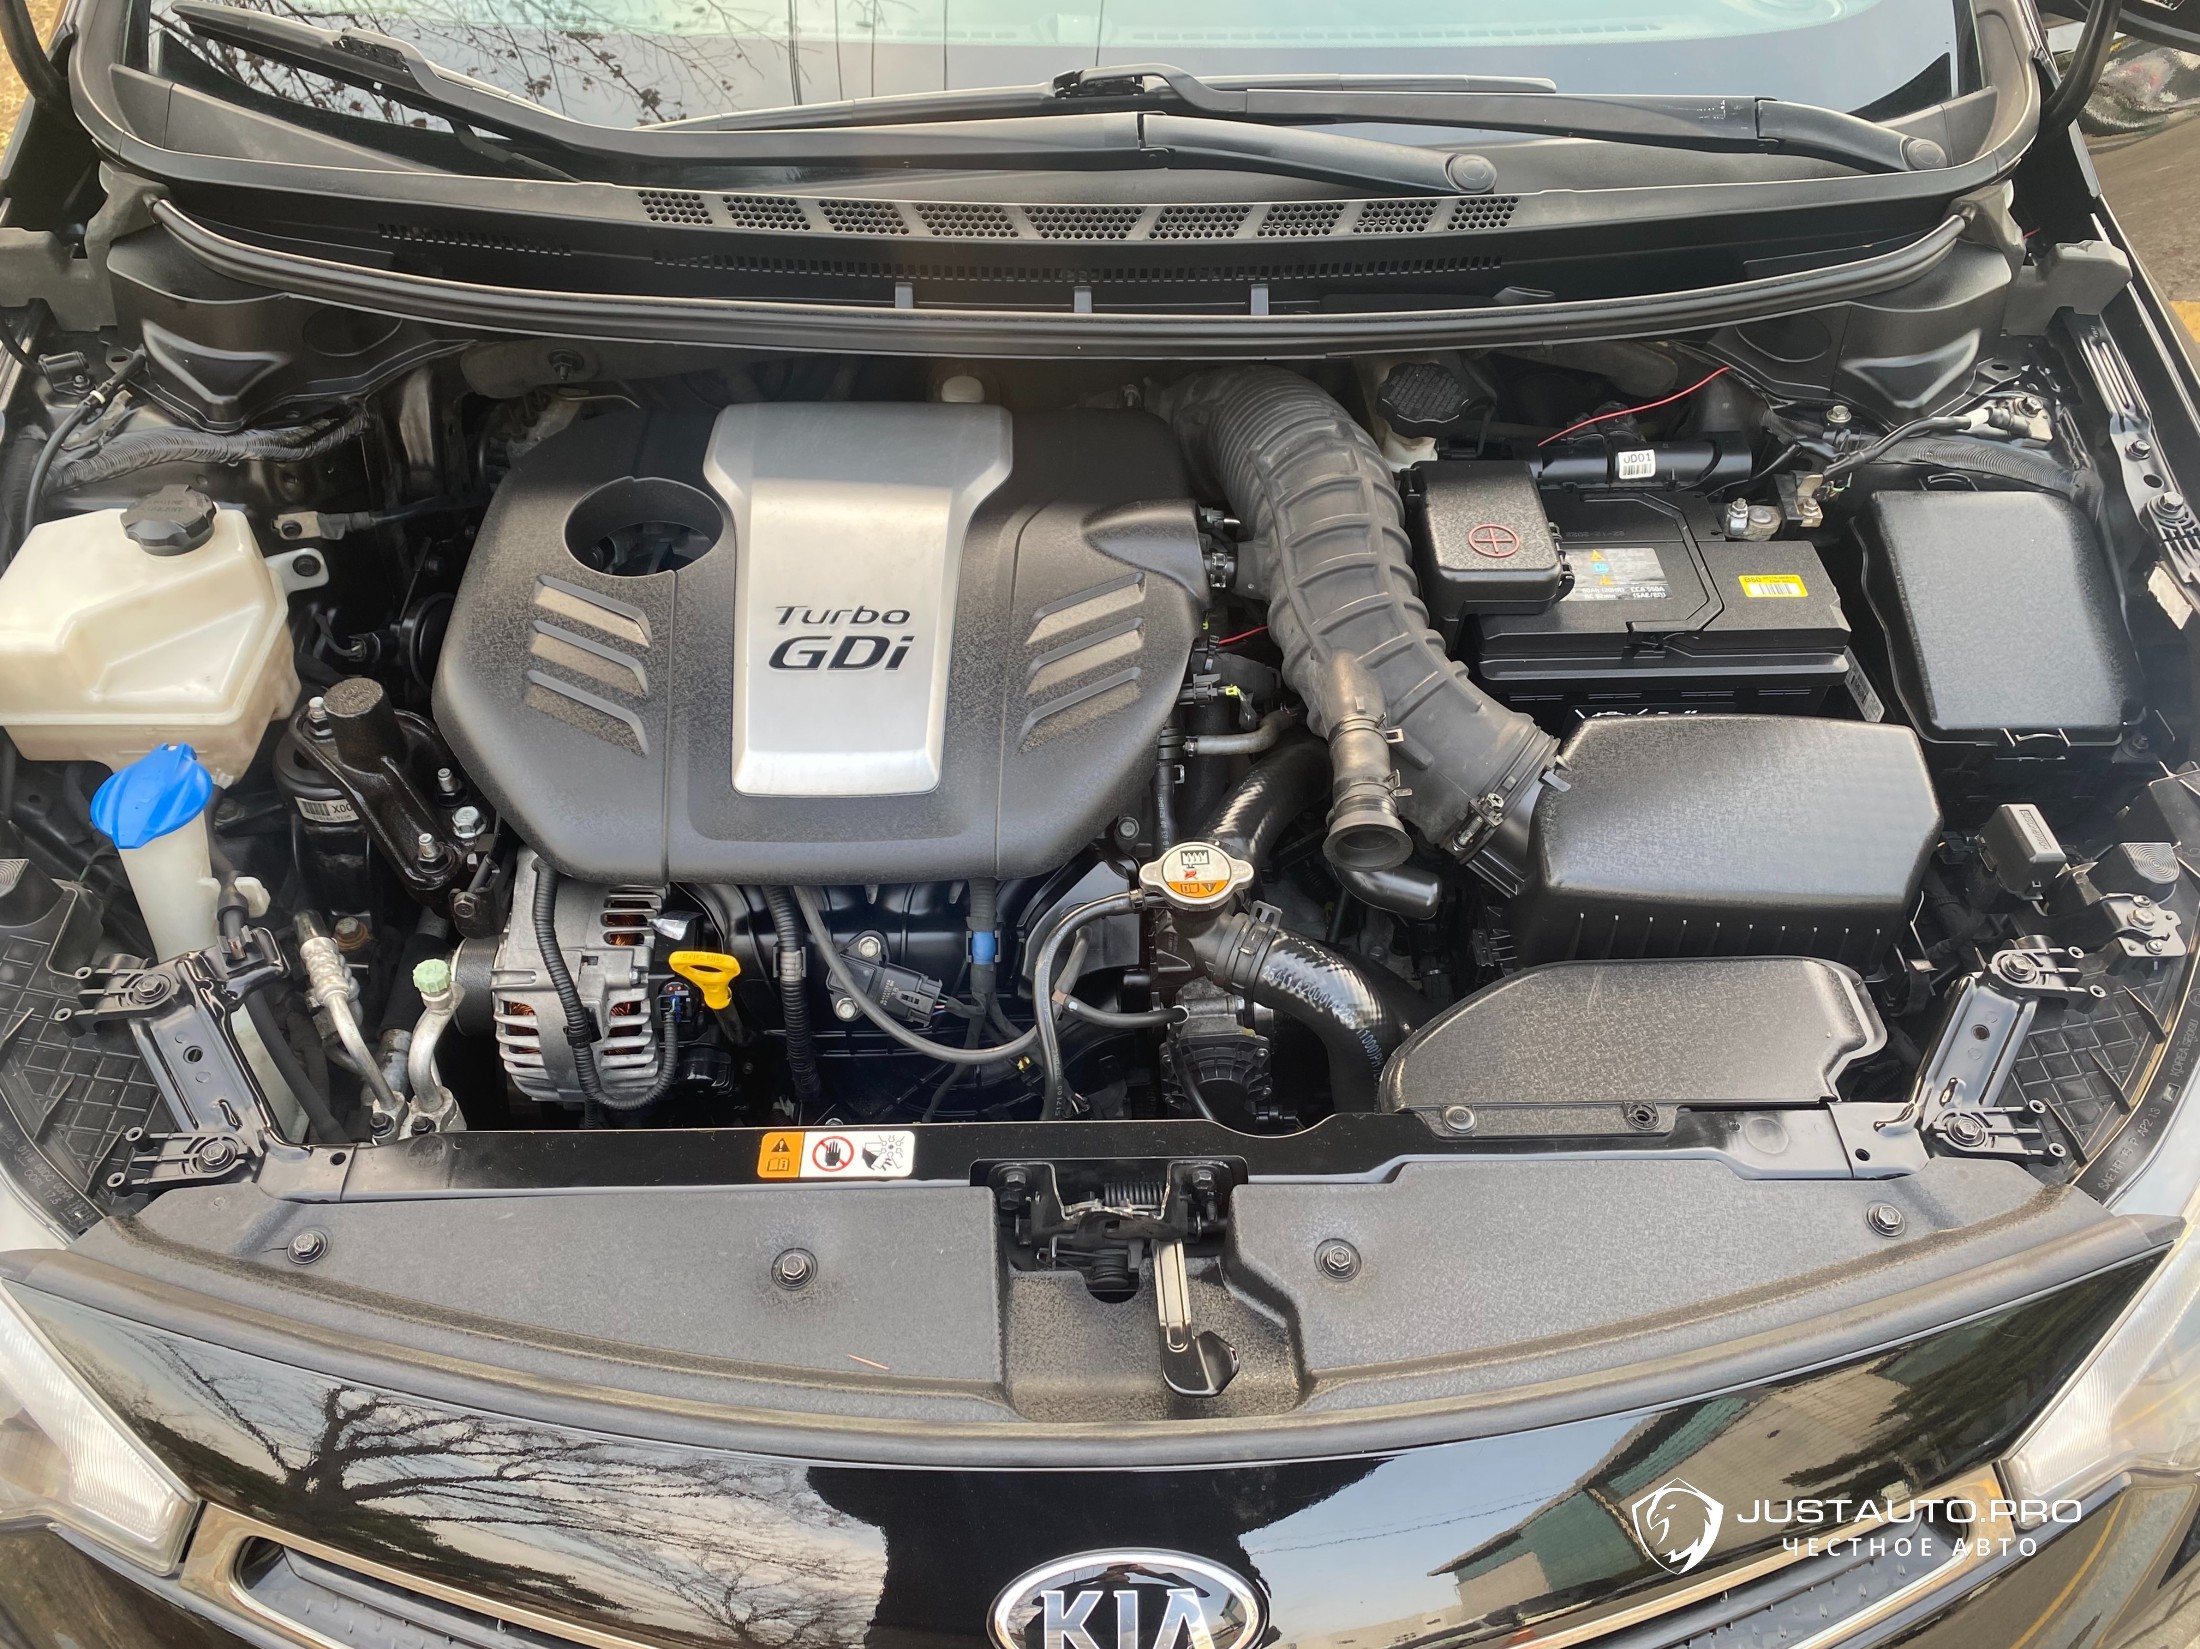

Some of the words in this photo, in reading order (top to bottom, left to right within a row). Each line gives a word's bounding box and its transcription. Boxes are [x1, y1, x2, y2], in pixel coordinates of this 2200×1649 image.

[776, 605, 911, 625] Turbo
[769, 635, 915, 670] GDi
[1040, 1588, 1216, 1649] KIA
